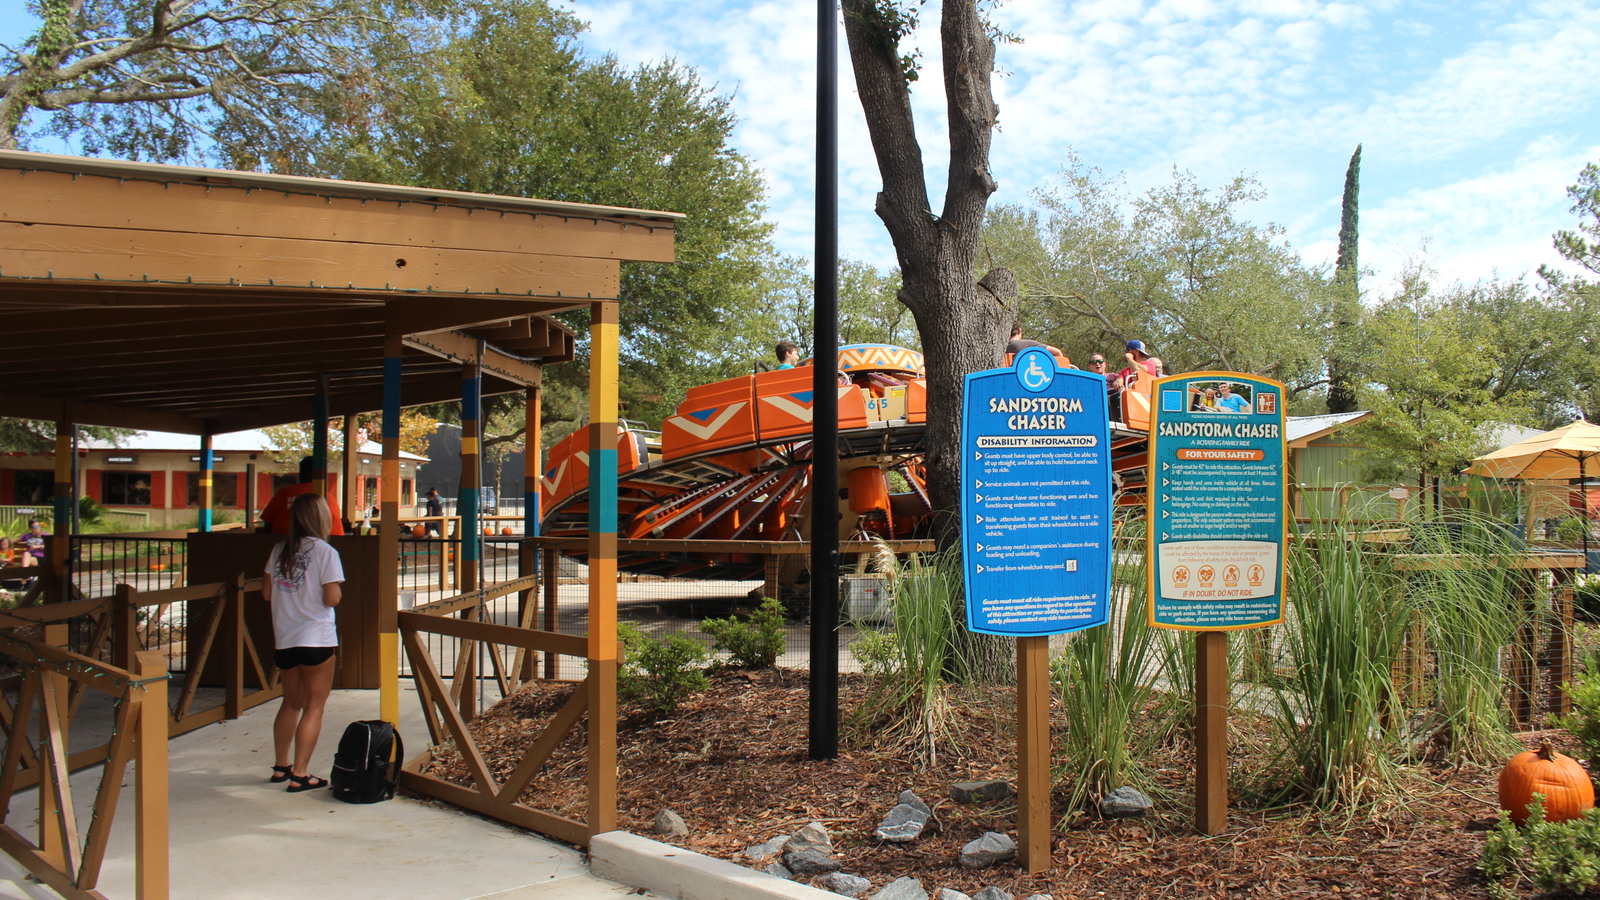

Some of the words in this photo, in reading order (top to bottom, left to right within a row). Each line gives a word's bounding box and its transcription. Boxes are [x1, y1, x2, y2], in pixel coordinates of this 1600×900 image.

[868, 400, 876, 410] 6
[881, 398, 888, 408] 5
[990, 398, 1083, 413] SANDSTORM
[1008, 414, 1066, 430] CHASER
[1160, 422, 1233, 438] SANDSTORM
[1234, 424, 1279, 438] CHASER
